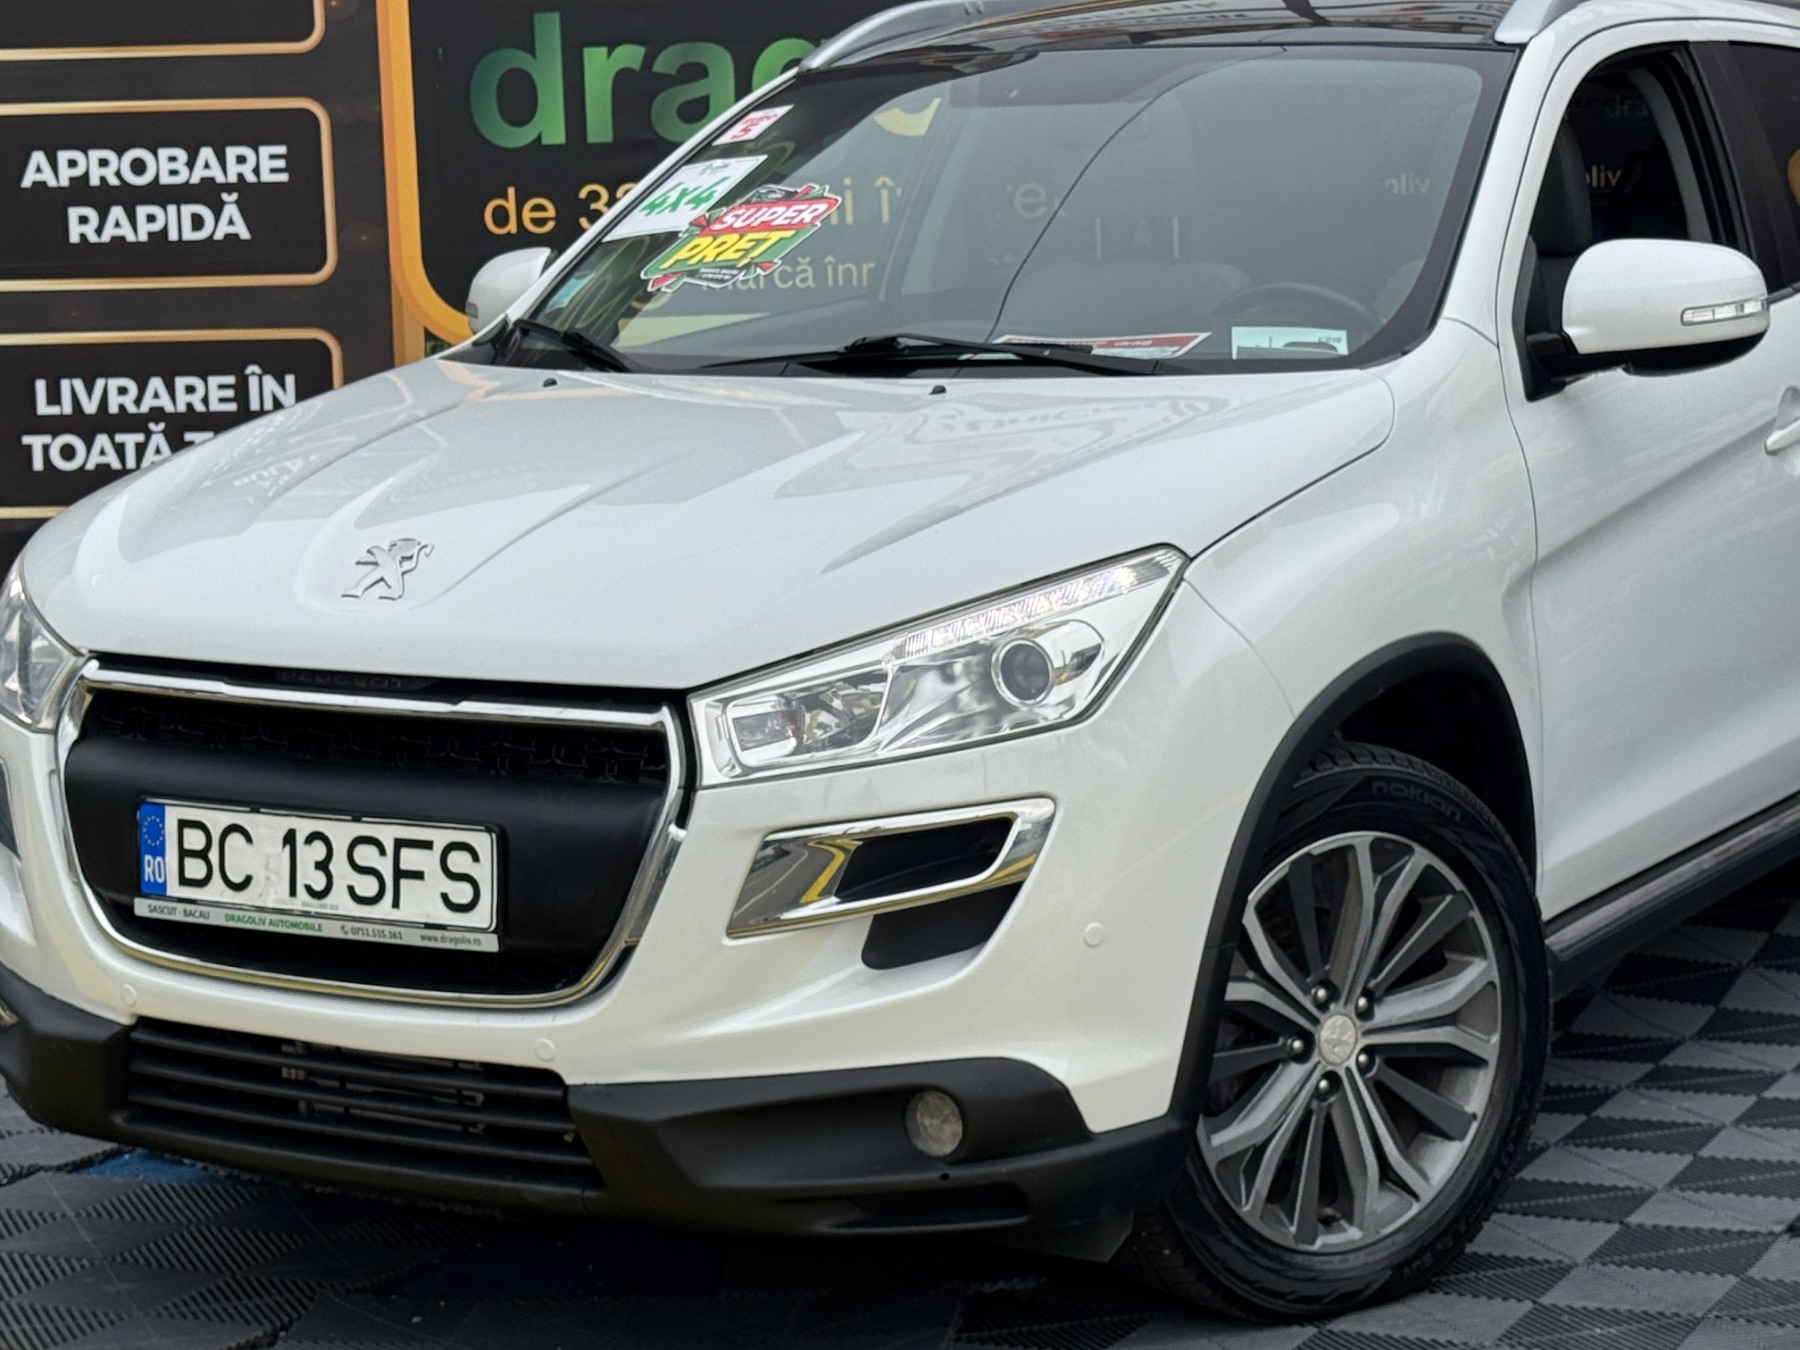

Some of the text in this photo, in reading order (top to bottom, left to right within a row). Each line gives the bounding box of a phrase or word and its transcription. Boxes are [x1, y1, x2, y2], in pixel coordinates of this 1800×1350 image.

[20, 144, 290, 189] APROBARE
[66, 192, 252, 244] RAPIDĂ
[484, 186, 556, 235] de
[711, 202, 830, 231] SUPER
[34, 364, 297, 416] LIVRARE ÎN
[21, 422, 173, 471] TOATĂ
[144, 819, 482, 914] RO BC 13 SFS
[148, 903, 177, 916] SASCUT
[224, 913, 266, 926] DRAGOLIV
[268, 918, 323, 932] AUTOMOBILE
